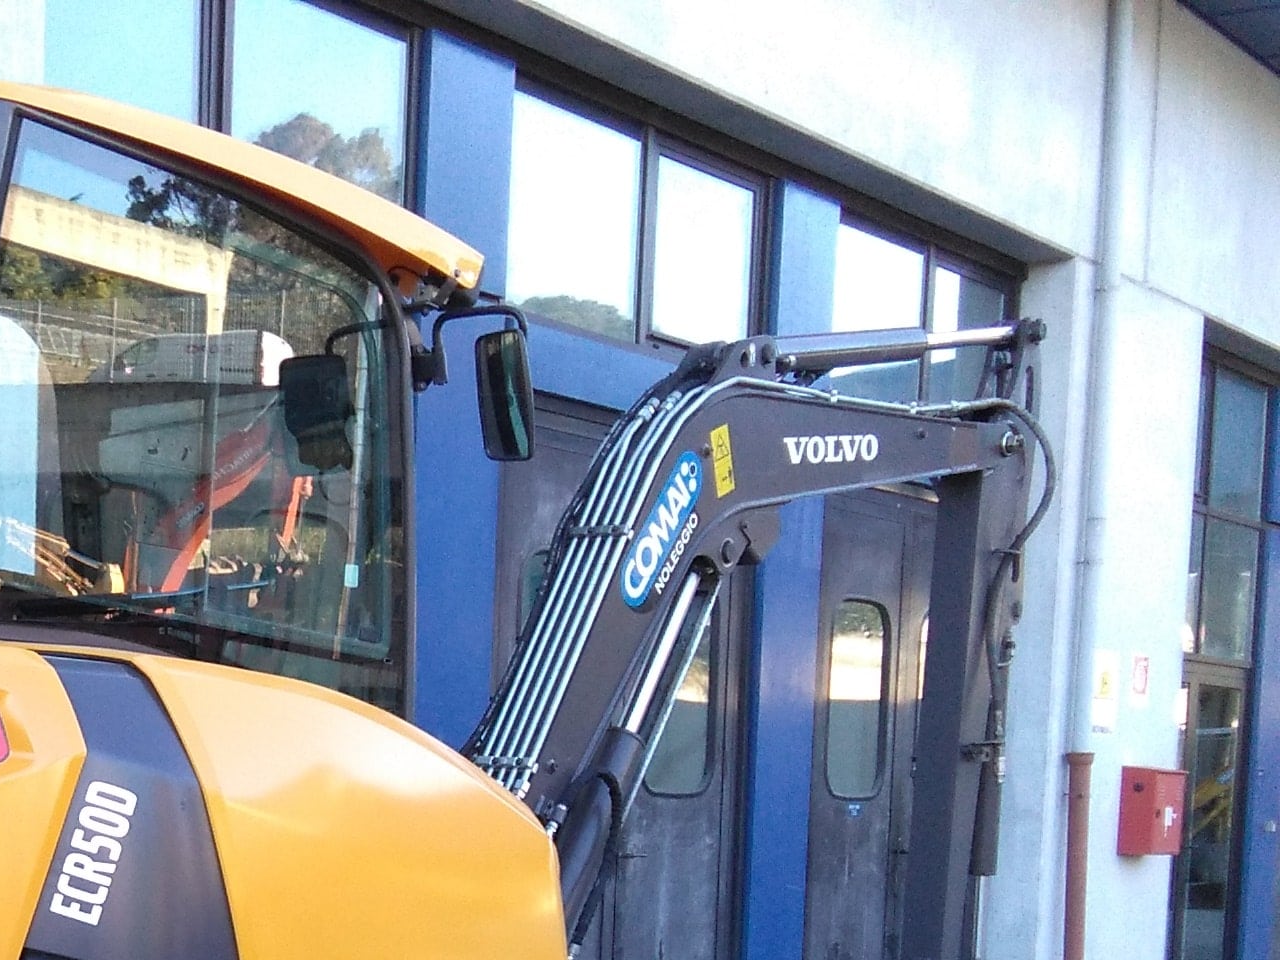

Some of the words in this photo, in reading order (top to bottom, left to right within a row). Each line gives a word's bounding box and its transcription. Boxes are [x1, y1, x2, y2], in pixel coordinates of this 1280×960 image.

[784, 434, 879, 465] VOLVO
[654, 512, 699, 595] NOLEGGIO
[49, 780, 138, 927] ECR50D
